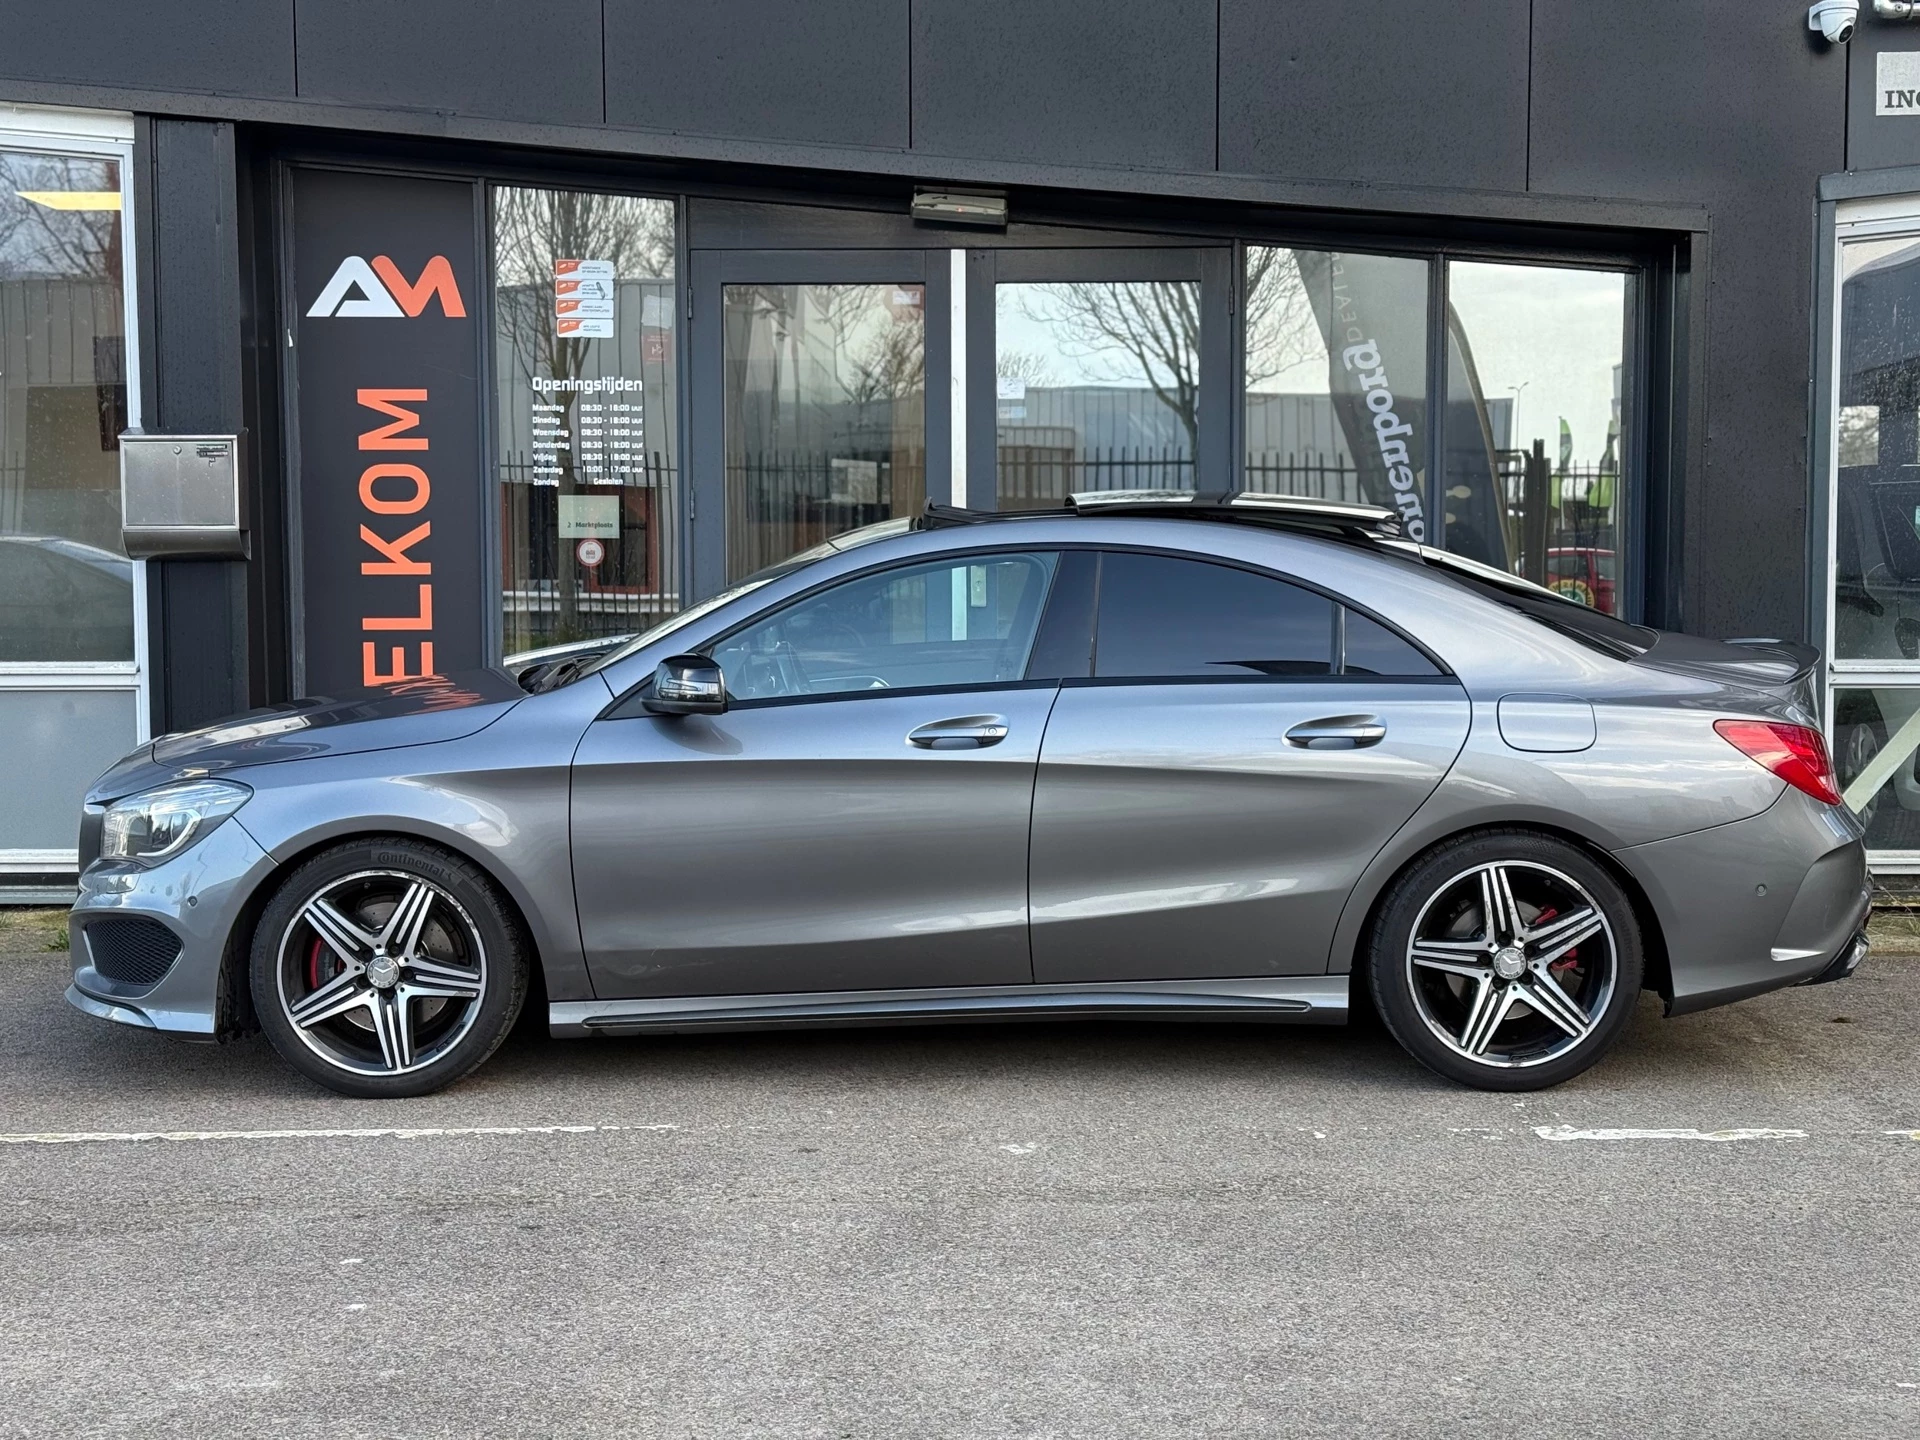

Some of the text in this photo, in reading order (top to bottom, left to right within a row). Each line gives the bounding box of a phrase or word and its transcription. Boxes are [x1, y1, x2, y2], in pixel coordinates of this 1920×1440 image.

[1884, 89, 1920, 108] IN
[305, 255, 467, 318] AM
[532, 376, 642, 394] Openingstijden
[532, 404, 564, 413] Maandag
[532, 417, 560, 425] Dinsdag
[533, 429, 569, 437] Woensdag
[533, 441, 570, 449] Donderdag
[533, 454, 556, 462] Vrijdag
[533, 466, 563, 474] Zaterdag
[533, 478, 559, 487] Zondag
[356, 388, 434, 688] ELKOM
[378, 851, 446, 877] Continental
